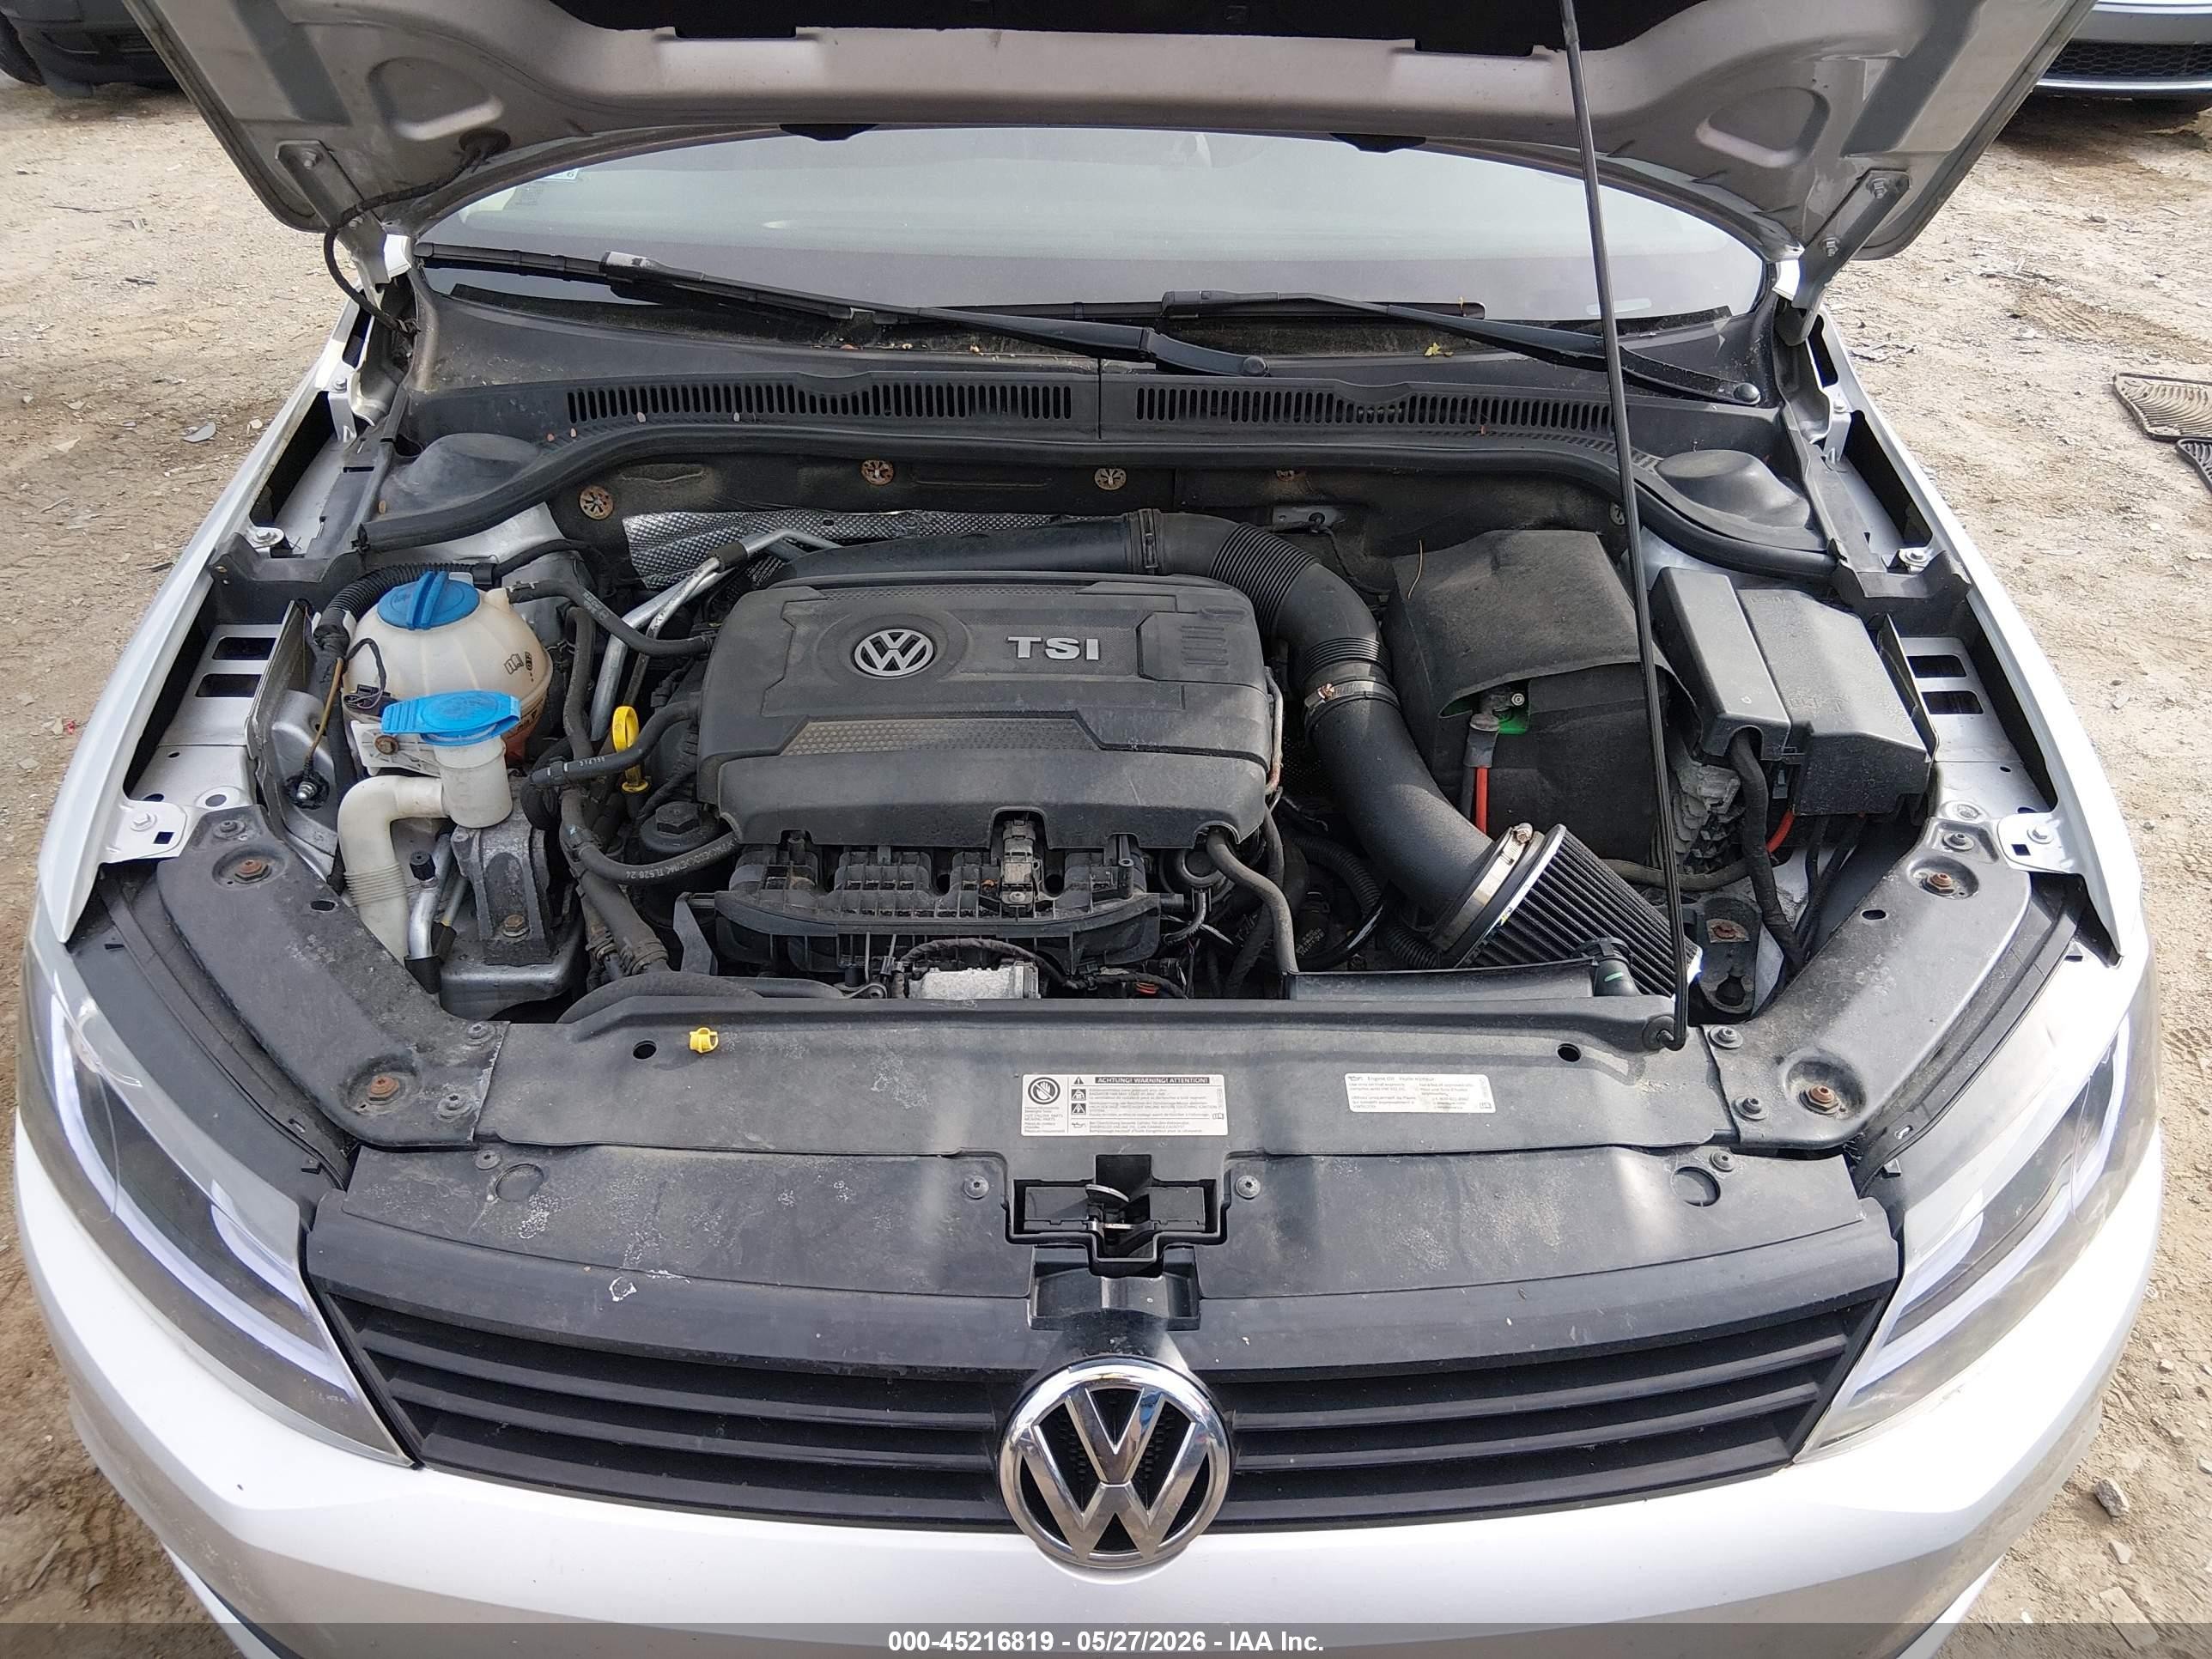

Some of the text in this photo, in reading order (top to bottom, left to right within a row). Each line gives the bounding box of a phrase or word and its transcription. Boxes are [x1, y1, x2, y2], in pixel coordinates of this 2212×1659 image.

[854, 629, 1100, 678] VW TSI
[1097, 1076, 1208, 1085] ACHTUNG! WARNING! ATTENTION!
[1002, 1358, 1231, 1567] VW
